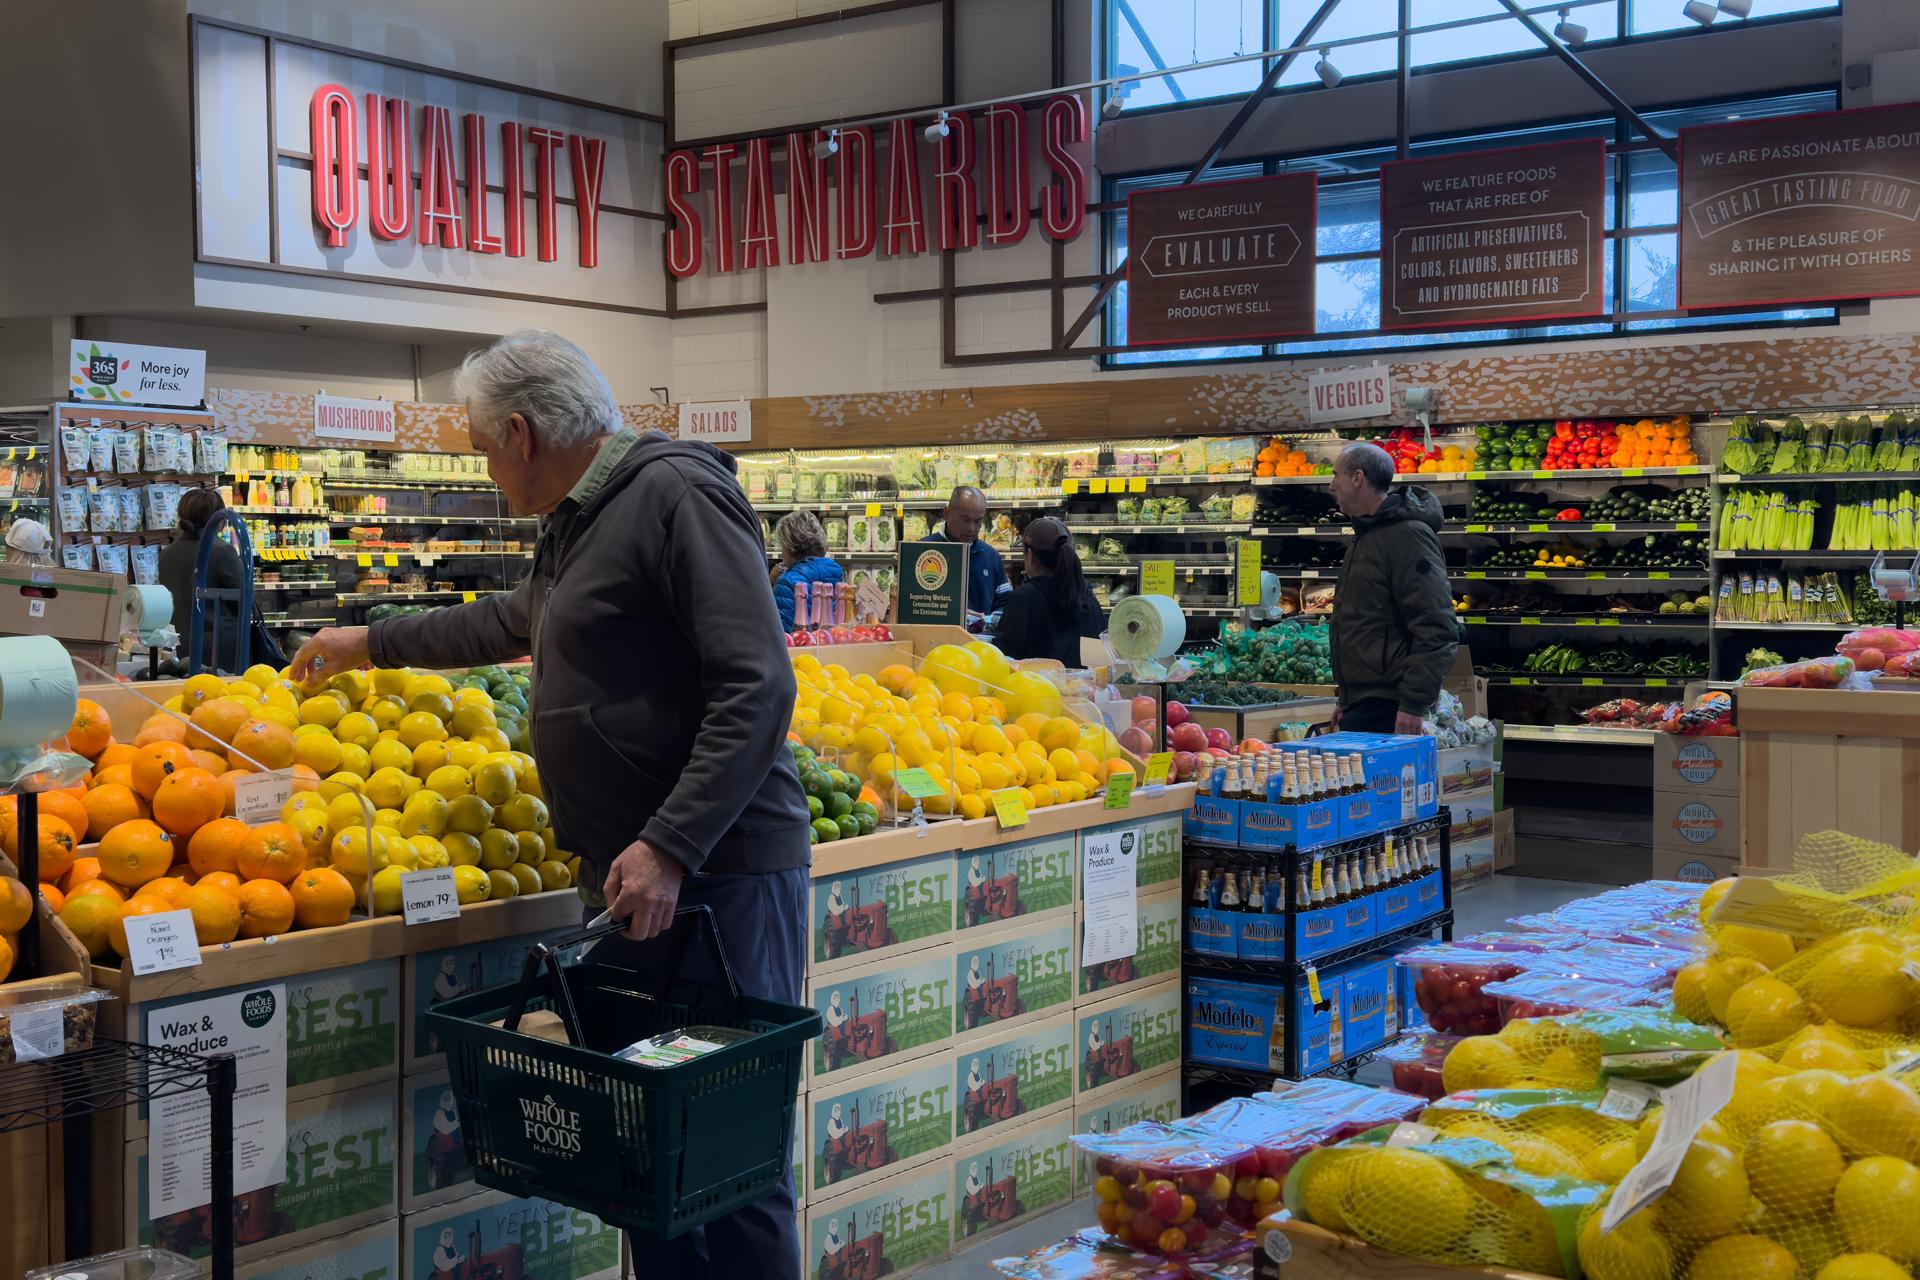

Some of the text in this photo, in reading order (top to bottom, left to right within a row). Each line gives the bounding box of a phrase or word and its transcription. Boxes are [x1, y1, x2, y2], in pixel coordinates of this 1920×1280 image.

[1701, 132, 1920, 166] WE ARE PASSIONATE ABOUT
[309, 84, 606, 268] QUALITY
[665, 94, 1084, 278] STANDARDS
[1422, 166, 1557, 193] WE FEATURE FOODS
[1178, 201, 1262, 221] WE CAREFULLY
[1428, 190, 1550, 214] THAT ARE FREE OF
[1706, 176, 1911, 225] GREAT TASTING FOOD
[1165, 233, 1276, 268] EVALUATE
[1410, 222, 1567, 253] ARTIFICIAL PRESERVATIVES,
[1731, 228, 1887, 253] & THE PLEASURE OF
[1401, 248, 1579, 280] COLORS, FLAVORS, SWEETENERS
[1708, 248, 1911, 276] SHARING IT WITH OTHERS
[1179, 282, 1260, 299] EACH & EVERY
[1418, 276, 1559, 304] AND HYDROGENATED FATS
[1168, 300, 1271, 319] PRODUCT WE SELL
[92, 362, 116, 375] 365
[141, 361, 190, 378] More joy
[139, 377, 181, 391] for less.
[1315, 378, 1383, 411] VEGGIES
[318, 405, 392, 433] MUSHROOMS
[690, 411, 737, 434] SALADS
[1250, 810, 1286, 825] Modelo
[1684, 808, 1711, 818] WHOLE
[1088, 857, 1114, 868] Produce
[1089, 846, 1103, 856] Wax
[1016, 851, 1069, 885] BEST
[406, 900, 435, 911] Lemon
[885, 874, 948, 911] BEST
[1193, 917, 1226, 932] Modelo
[1016, 947, 1069, 983] BEST
[244, 996, 272, 1009] WHOLE
[245, 1005, 272, 1018] FOODS
[885, 980, 948, 1019] BEST
[1353, 991, 1379, 1014] Modelo
[161, 1015, 213, 1040] Wax &
[1131, 1008, 1177, 1045] BEST
[1200, 1001, 1254, 1029] Modelo
[161, 1035, 228, 1061] Produce
[1016, 1044, 1069, 1087] BEST
[518, 1098, 580, 1131] WHOLE
[885, 1085, 949, 1129] BEST
[524, 1119, 581, 1153] FOODS
[533, 1143, 574, 1161] MARKET
[1014, 1142, 1068, 1184] BEST
[882, 1192, 946, 1239] BEST
